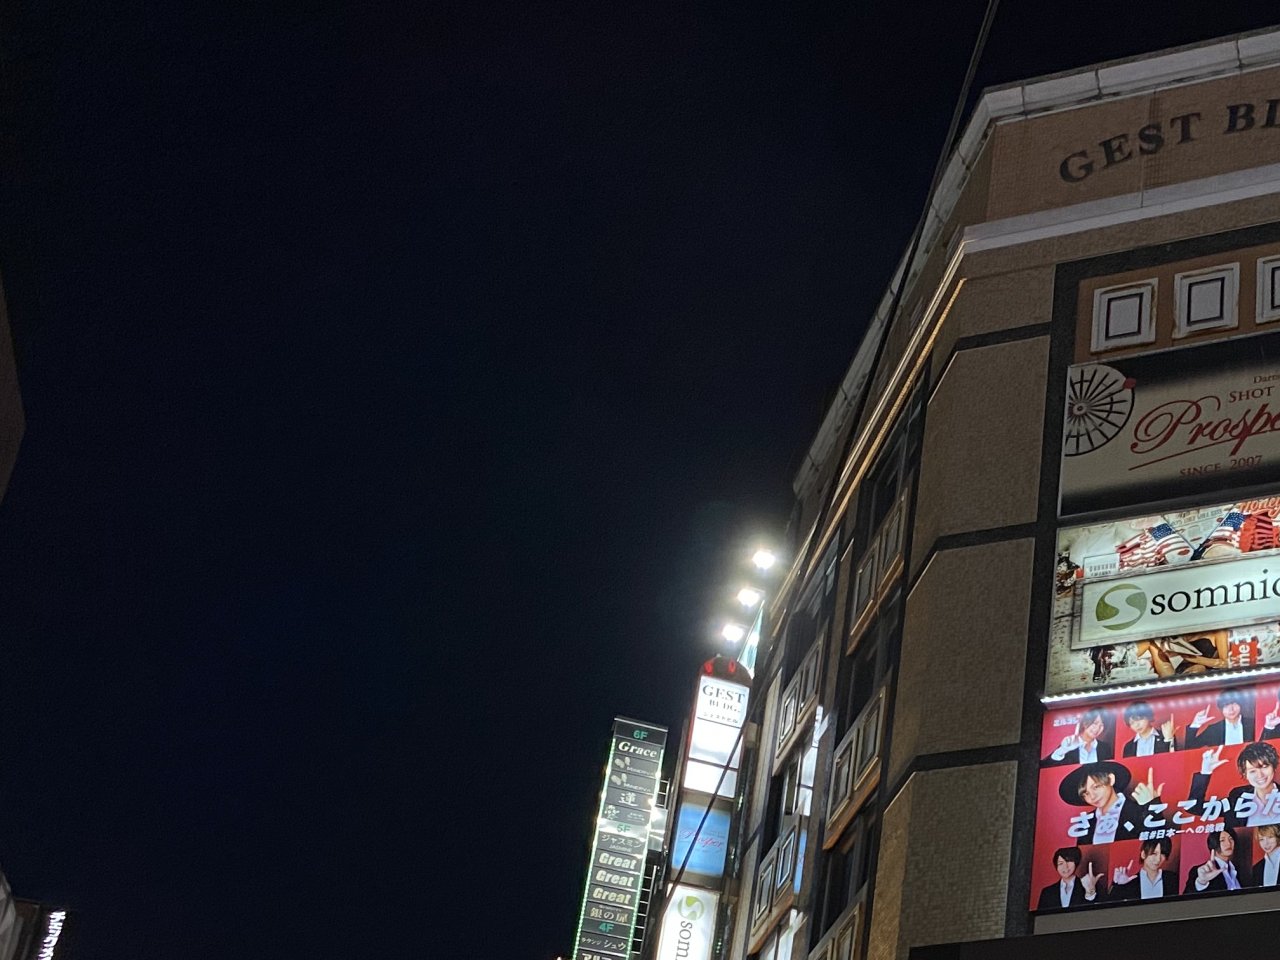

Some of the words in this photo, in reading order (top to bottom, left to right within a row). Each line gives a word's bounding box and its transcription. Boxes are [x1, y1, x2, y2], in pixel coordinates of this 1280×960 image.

[1059, 112, 1202, 185] GEST
[1229, 386, 1275, 403] SHOT
[1180, 462, 1221, 477] SINCE
[1230, 454, 1262, 470] 2007
[702, 684, 747, 704] GEST
[633, 730, 648, 740] 6F
[618, 741, 657, 758] Grace
[599, 852, 637, 870] Great
[595, 870, 634, 887] Great
[592, 887, 631, 904] Great
[599, 923, 615, 933] 4F
